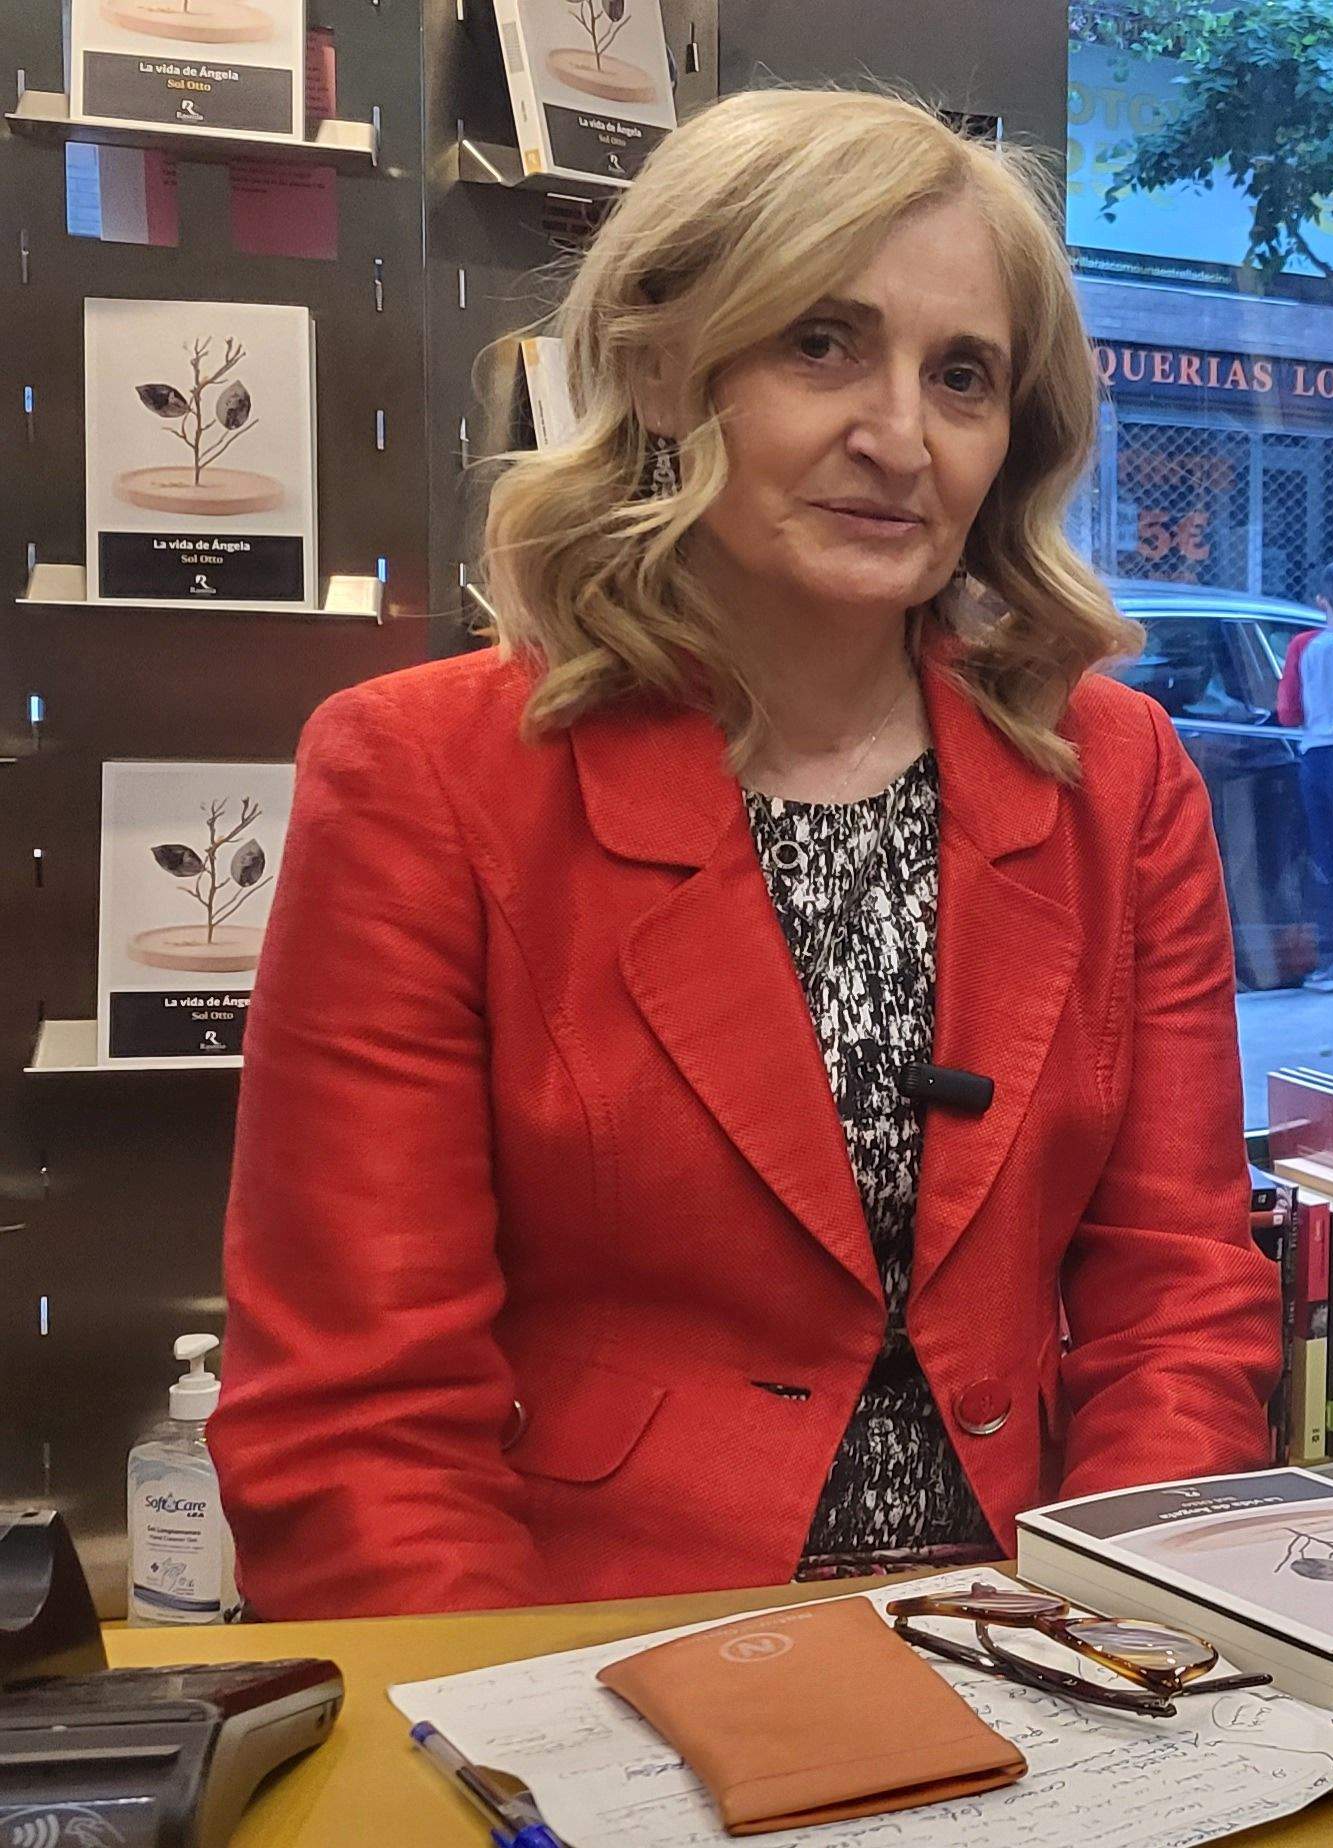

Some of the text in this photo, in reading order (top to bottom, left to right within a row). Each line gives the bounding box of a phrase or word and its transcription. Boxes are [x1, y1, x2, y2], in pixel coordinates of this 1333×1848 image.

[140, 62, 239, 81] La vida de Ángela
[167, 80, 211, 92] Sol Otto
[1096, 346, 1272, 392] QUERIAS
[153, 538, 250, 552] La vida de Ángela
[181, 554, 223, 564] Sol Otto
[165, 996, 250, 1008] La vida de Ánge
[192, 1011, 233, 1020] Sol Otto
[145, 1495, 206, 1512] Soft Care
